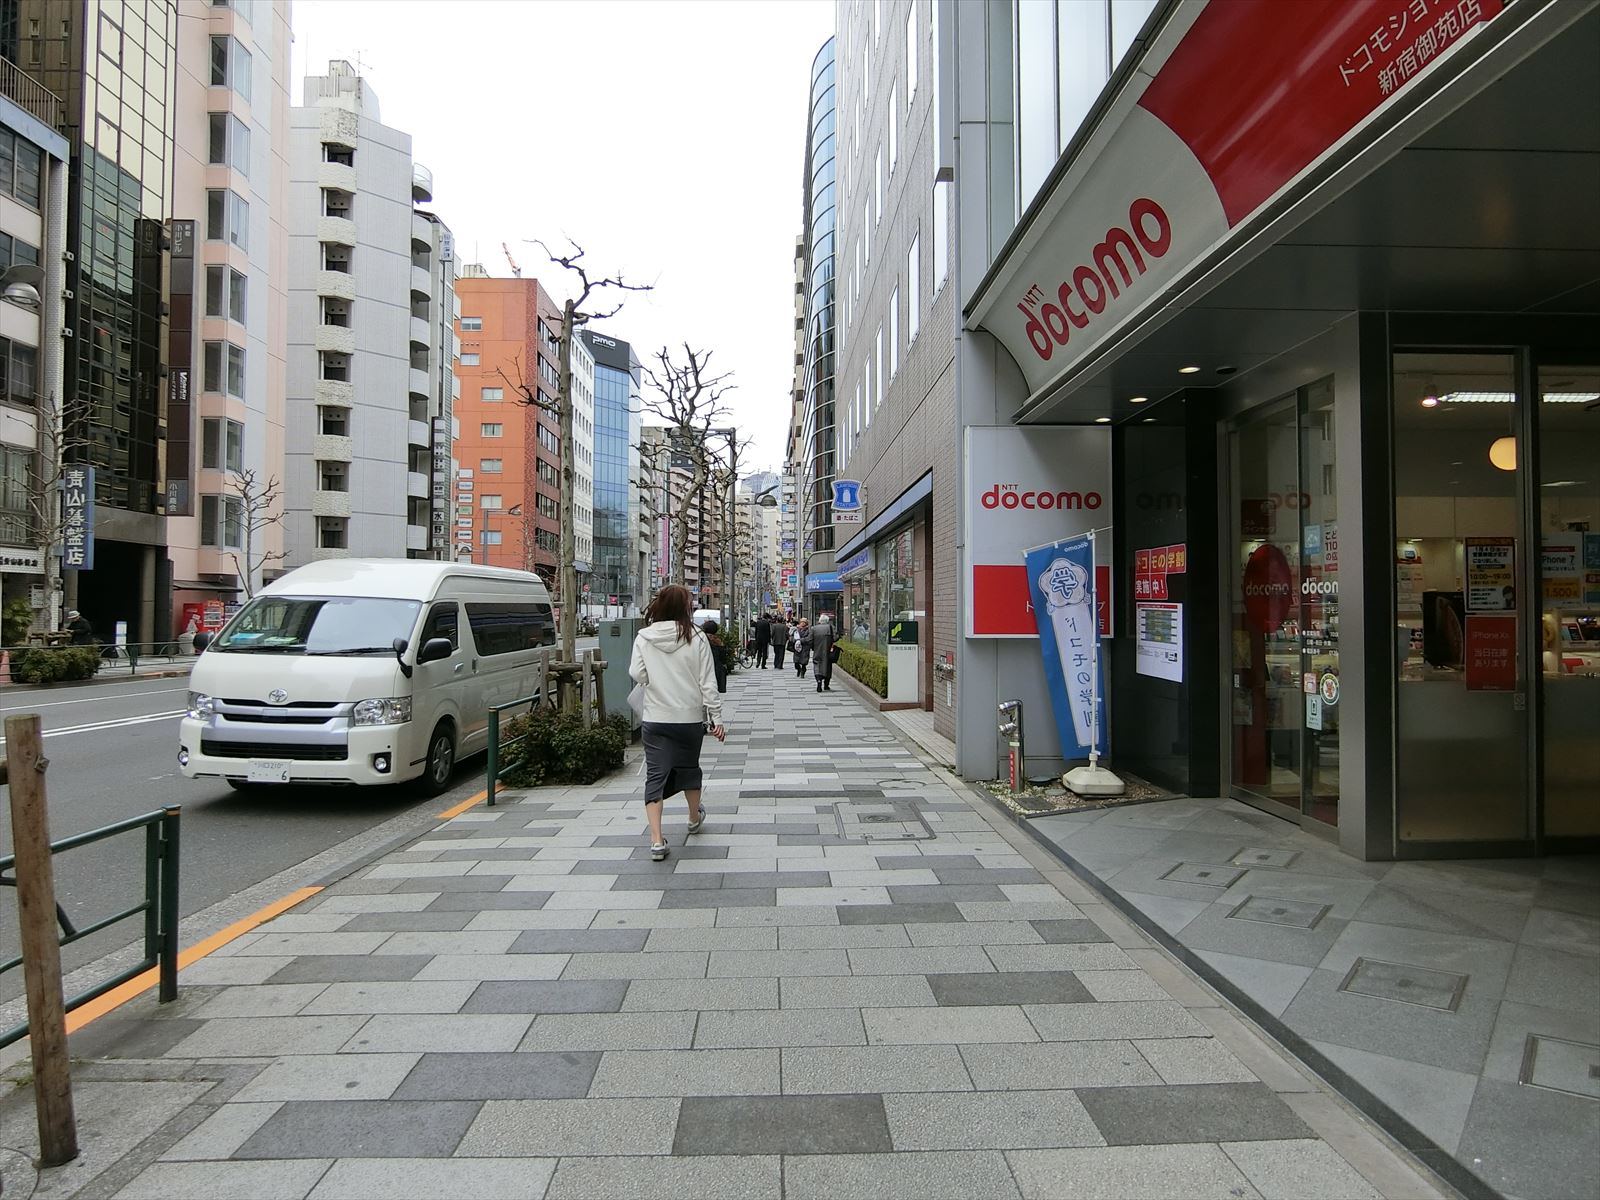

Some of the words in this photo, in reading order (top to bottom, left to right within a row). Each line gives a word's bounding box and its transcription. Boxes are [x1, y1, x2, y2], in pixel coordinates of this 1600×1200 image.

[1339, 0, 1441, 86] ドコモショ
[1377, 0, 1482, 95] 新宿御苑店
[1017, 197, 1172, 361] docomo
[1023, 284, 1045, 308] NTT
[981, 484, 1102, 510] docomo
[1136, 551, 1185, 571] ドコモの学割
